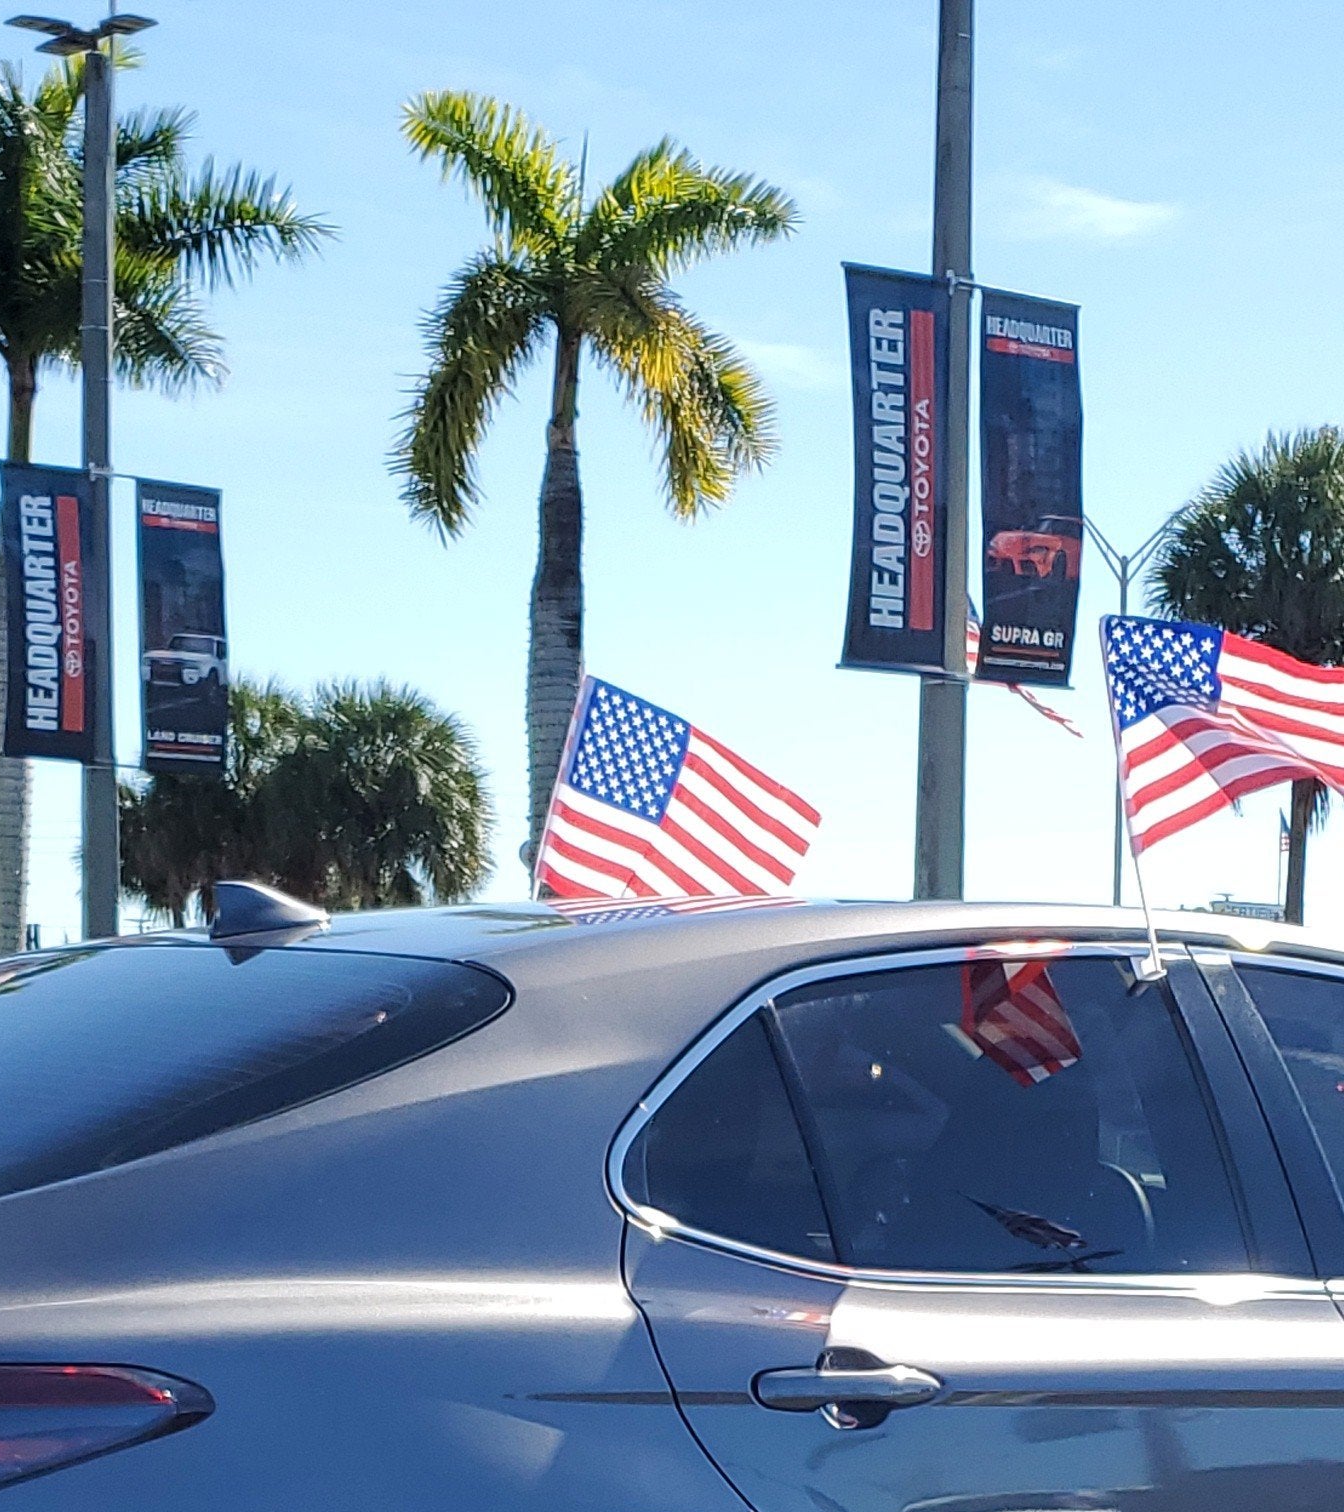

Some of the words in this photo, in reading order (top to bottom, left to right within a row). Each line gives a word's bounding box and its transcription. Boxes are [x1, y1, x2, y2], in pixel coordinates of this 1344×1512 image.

[985, 314, 1073, 350] HEADQUARTER
[869, 307, 910, 630] HEADQUARTER
[912, 399, 931, 513] TOYOTA
[20, 494, 62, 731] HEADQUARTER
[64, 561, 81, 646] TOYOTA
[990, 624, 1040, 646] SUPRA
[1042, 630, 1065, 648] GR
